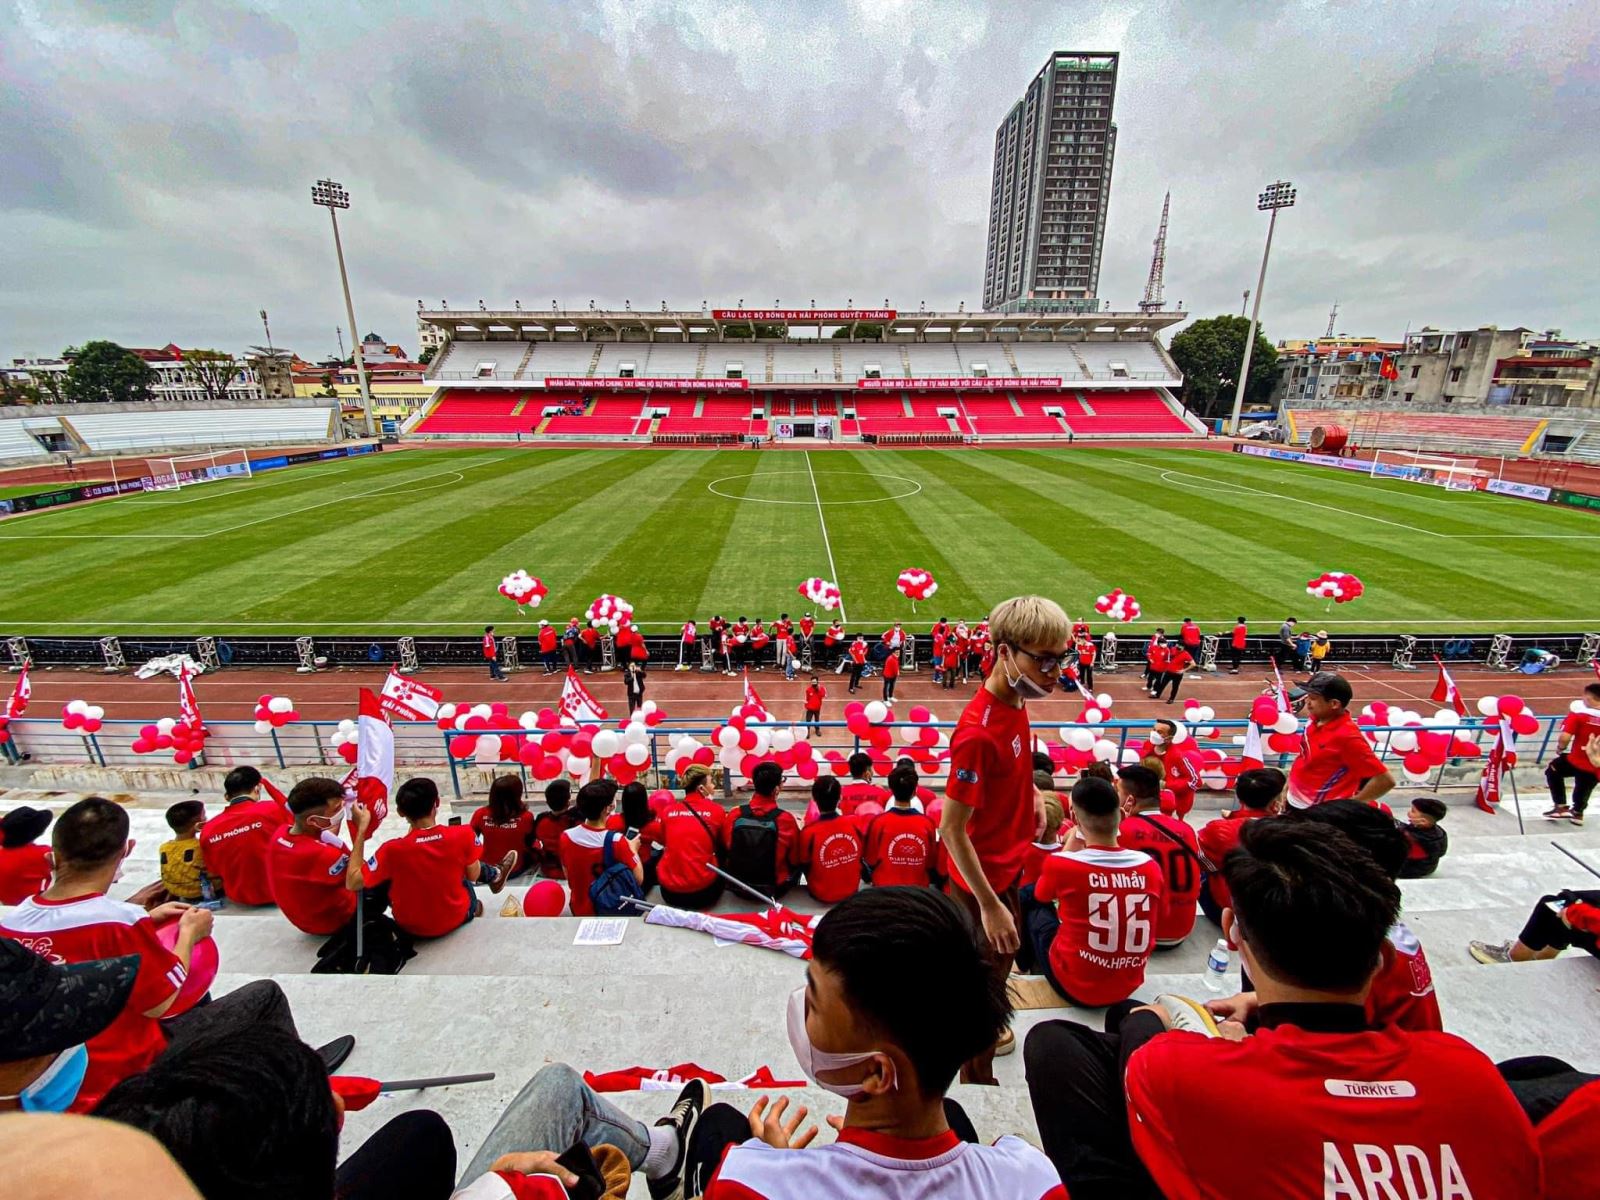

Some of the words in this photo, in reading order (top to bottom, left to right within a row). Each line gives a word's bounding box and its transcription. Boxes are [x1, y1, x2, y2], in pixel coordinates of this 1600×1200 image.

[251, 821, 263, 830] FC
[1088, 872, 1109, 888] Cù
[1111, 870, 1146, 890] Nhầy
[1088, 892, 1151, 953] 96
[1344, 1083, 1399, 1096] TÜRKİYE
[1323, 1142, 1472, 1200] ARDA
